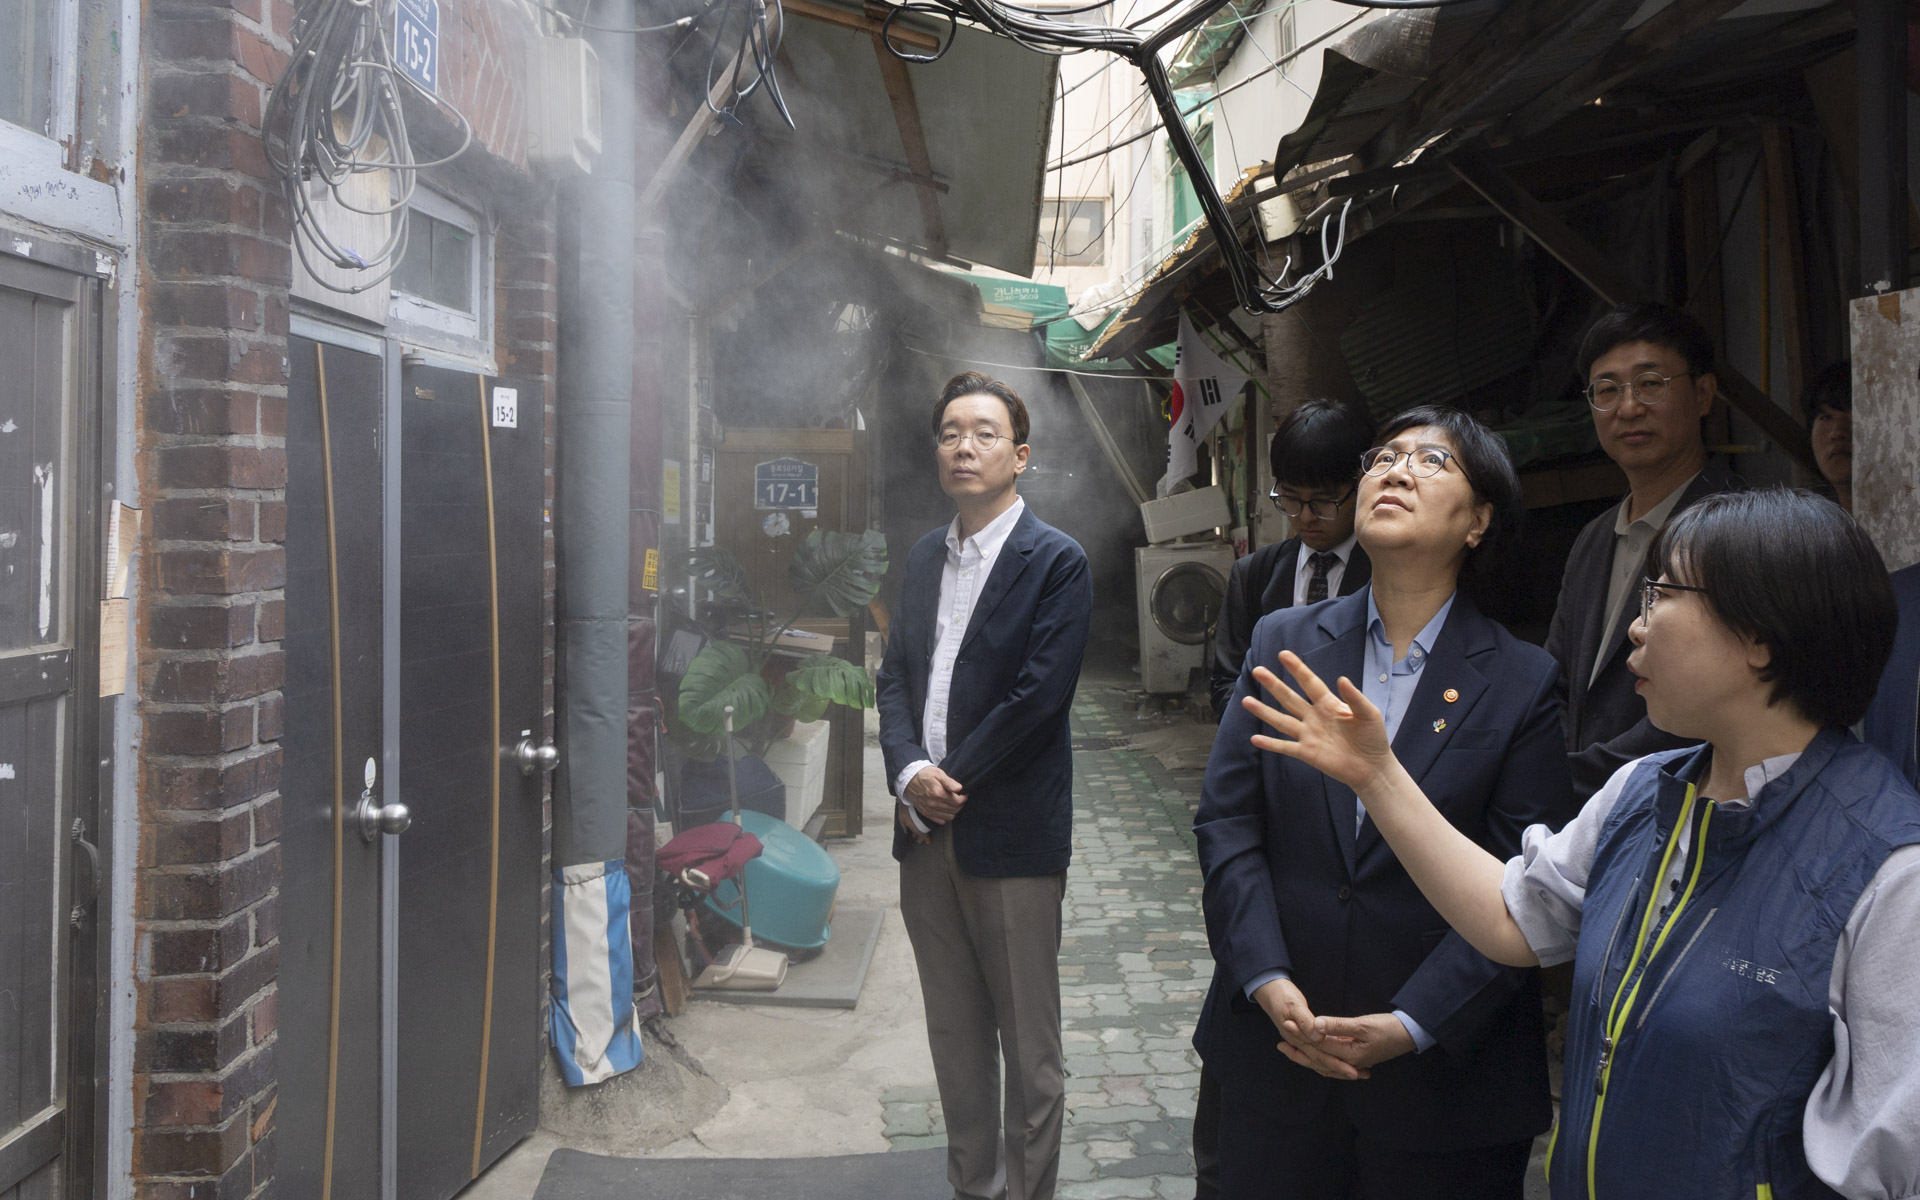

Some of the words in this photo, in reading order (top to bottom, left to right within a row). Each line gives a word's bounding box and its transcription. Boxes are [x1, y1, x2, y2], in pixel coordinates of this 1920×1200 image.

[403, 20, 431, 83] 15-2
[496, 406, 514, 422] 15-2
[766, 483, 806, 503] 17-1
